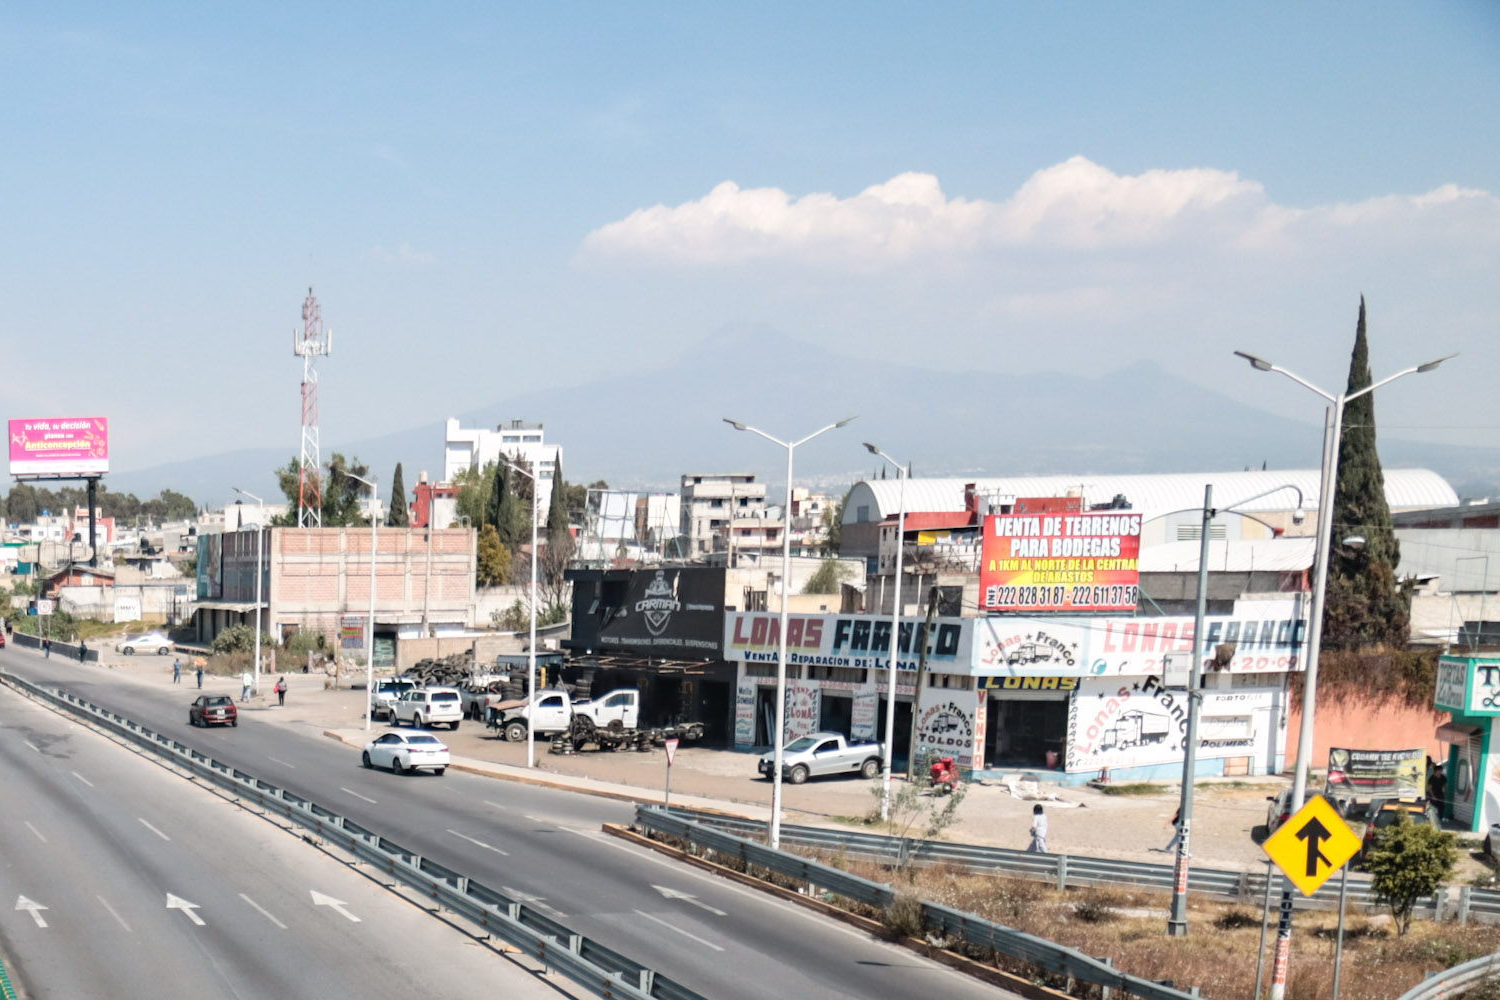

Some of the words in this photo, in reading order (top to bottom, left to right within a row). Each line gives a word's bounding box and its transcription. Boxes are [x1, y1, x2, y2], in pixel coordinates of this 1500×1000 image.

[61, 420, 91, 430] decisión
[25, 440, 91, 450] Anticoncepción
[995, 516, 1040, 537] VENTA
[1043, 516, 1062, 537] DE
[1065, 516, 1141, 536] TERRENOS
[1010, 537, 1049, 557] PARA
[1051, 537, 1121, 557] BODEGAS
[989, 559, 997, 571] A
[999, 559, 1019, 571] 1KM
[1020, 559, 1032, 571] AL
[1034, 559, 1066, 571] NORTE
[1067, 559, 1081, 571] DE
[1083, 559, 1095, 571] LA
[1033, 570, 1045, 583] DE
[1047, 570, 1094, 583] ABASTOS
[998, 586, 1016, 604] 222
[1019, 586, 1037, 604] 828
[1072, 586, 1091, 604] 222
[1093, 585, 1109, 604] 611
[635, 598, 681, 612] CARMAN
[731, 616, 824, 649] LONAS
[834, 619, 962, 657] FRANCO
[1104, 621, 1196, 653] LONAS
[1205, 620, 1308, 652] FRANCO
[982, 635, 1021, 665] Lonas
[1036, 631, 1075, 666] Franco
[985, 676, 1078, 690] LONAS
[916, 704, 941, 732] Lonas
[948, 701, 972, 737] Franco
[974, 690, 987, 767] VENTA
[1076, 686, 1131, 755] Lonas
[919, 733, 972, 748] TOLDOS
